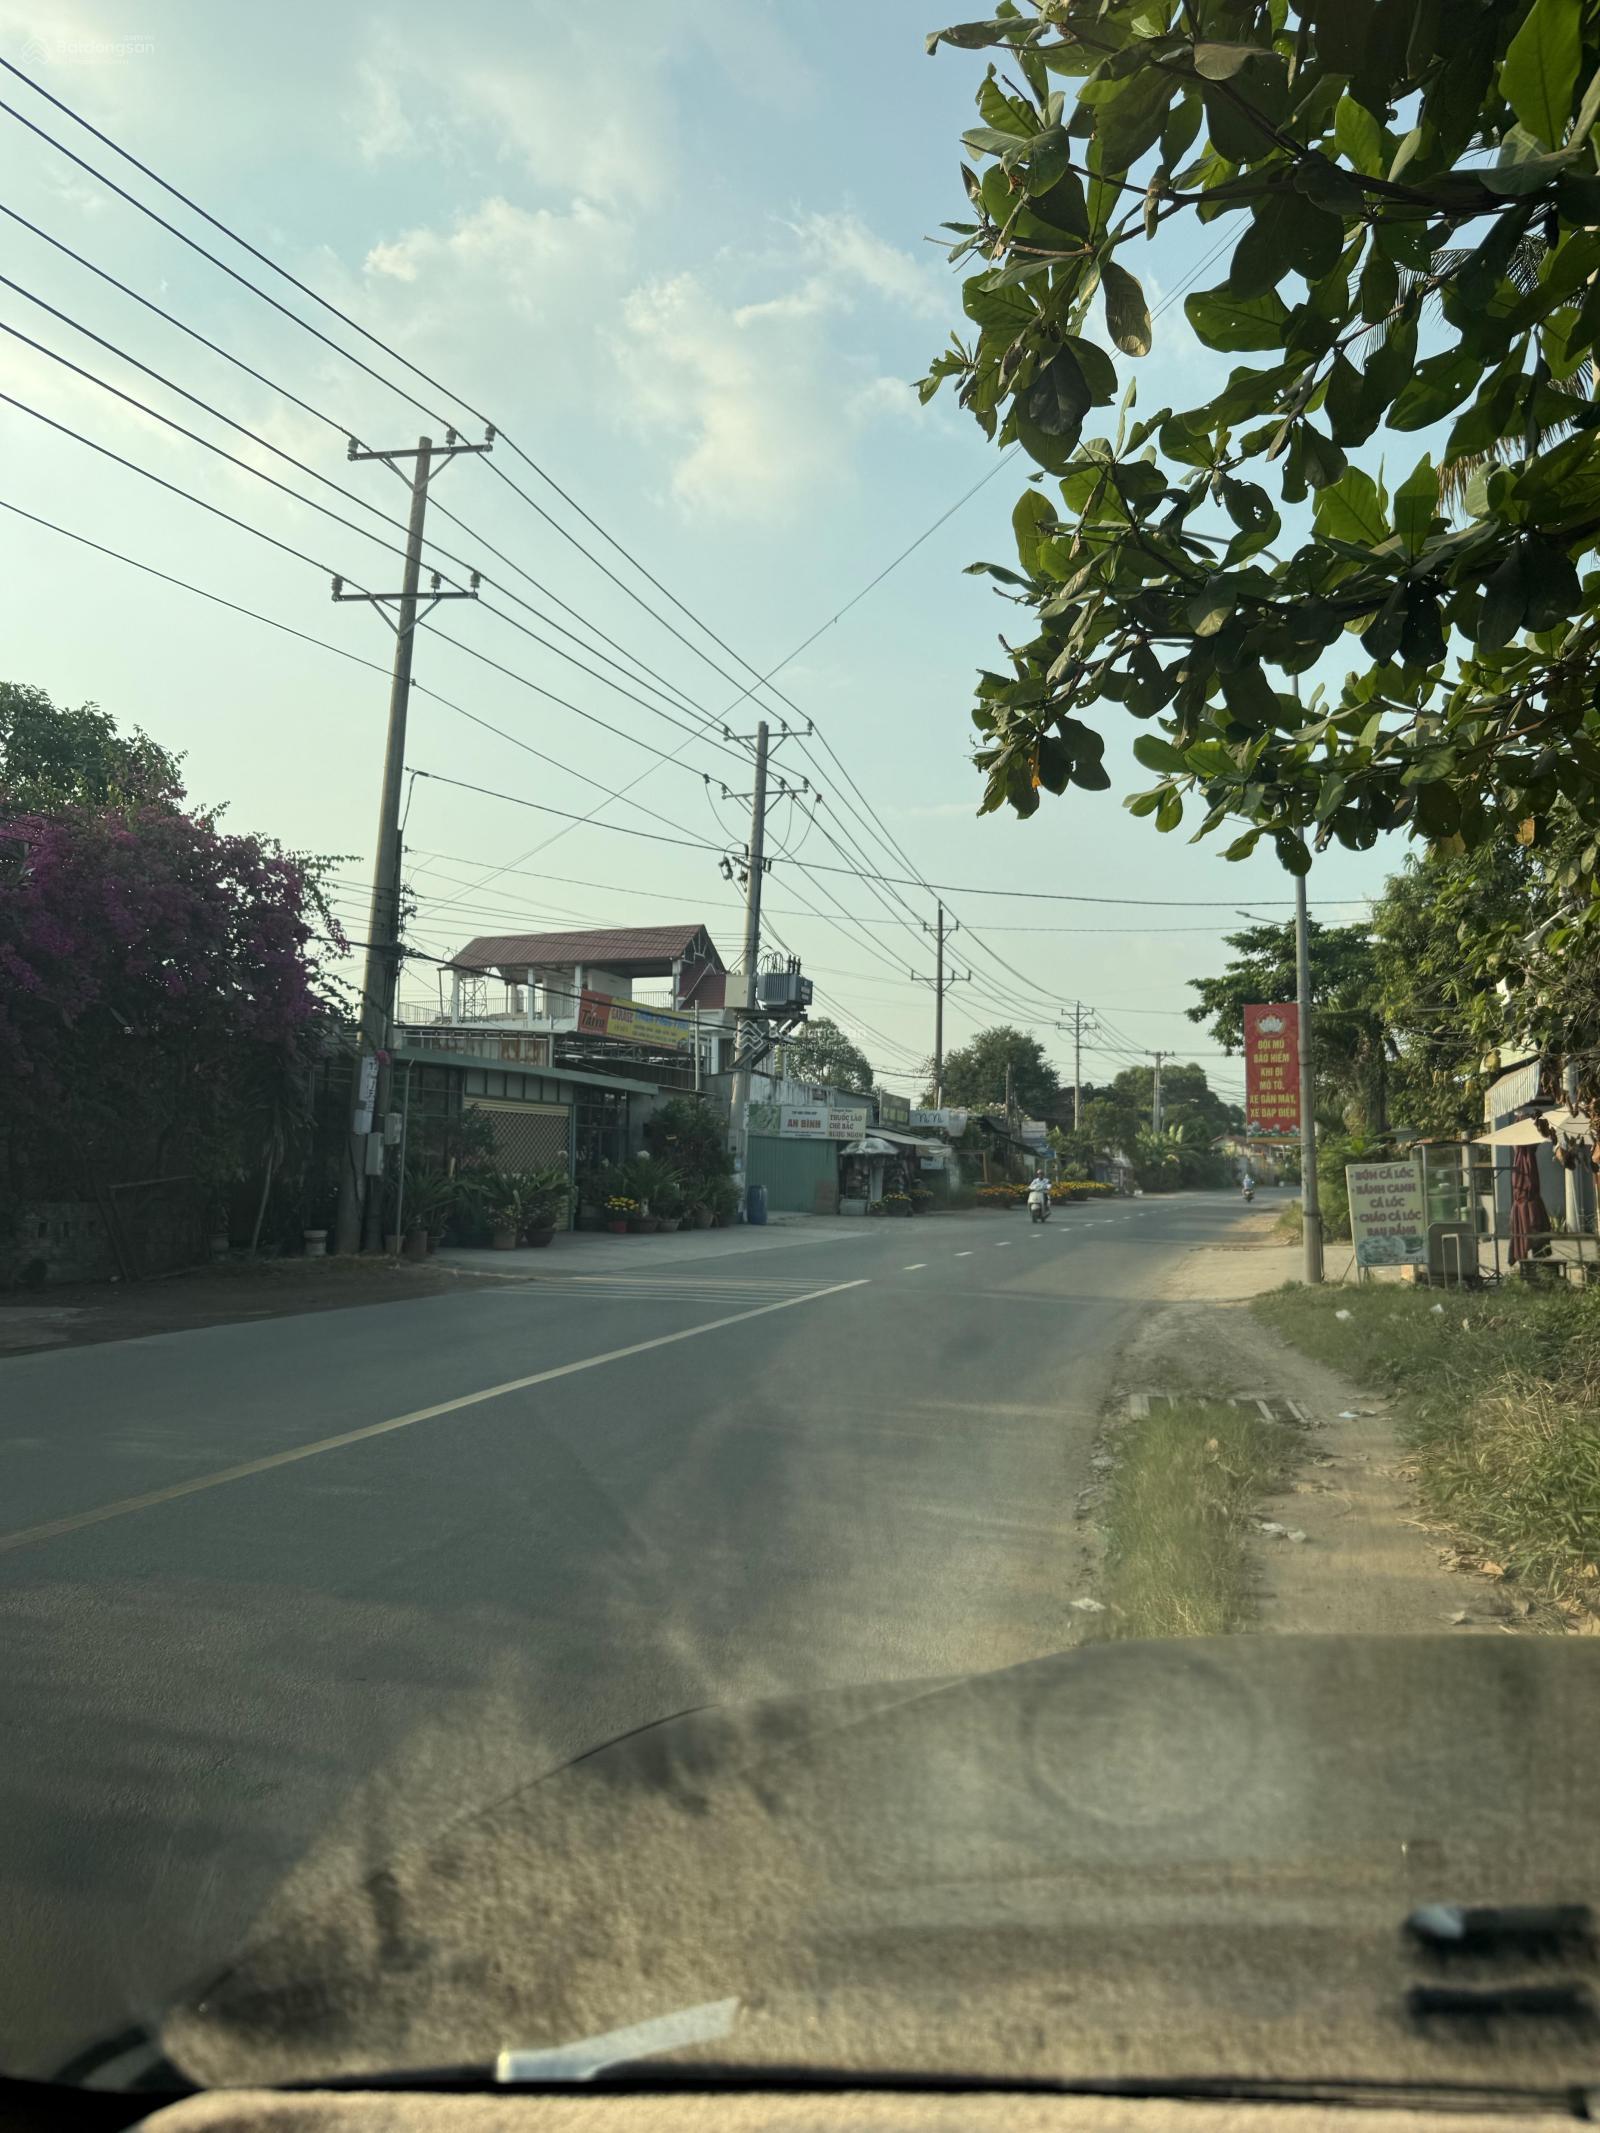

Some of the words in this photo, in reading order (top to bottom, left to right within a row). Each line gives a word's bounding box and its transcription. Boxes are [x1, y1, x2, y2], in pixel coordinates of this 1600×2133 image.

[1394, 1167, 1415, 1178] LÓC
[1386, 1183, 1416, 1193] CANH
[1370, 1196, 1384, 1208] CÁ
[1385, 1195, 1405, 1207] LÓC
[1388, 1209, 1402, 1221] CÁ
[1403, 1209, 1422, 1220] LÓC
